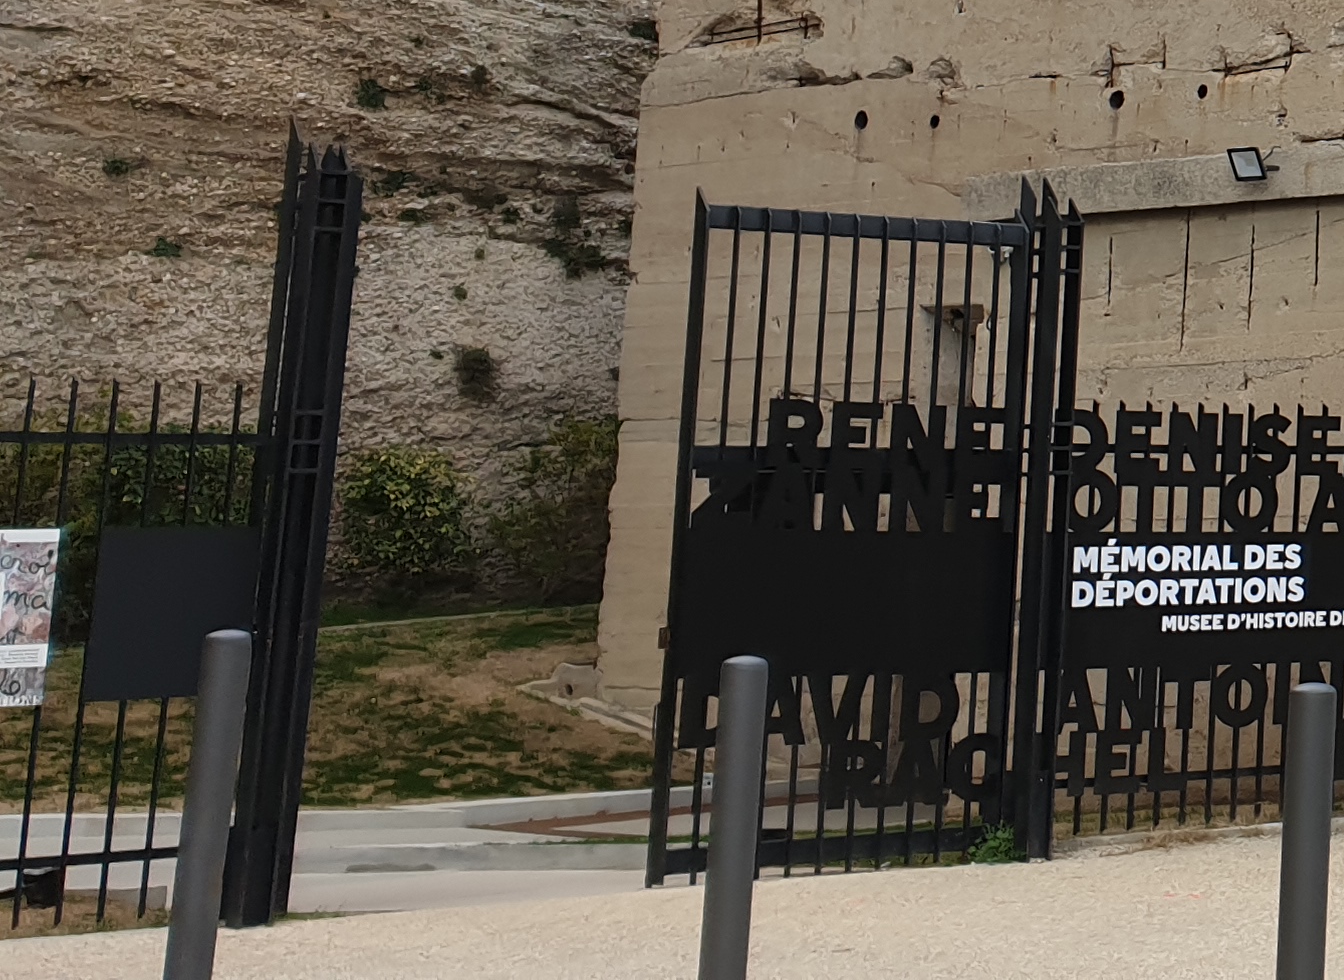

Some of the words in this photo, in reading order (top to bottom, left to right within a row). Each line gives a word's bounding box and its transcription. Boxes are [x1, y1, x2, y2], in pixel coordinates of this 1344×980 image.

[1071, 407, 1343, 475] DENISE
[1068, 469, 1281, 534] OTTO
[1073, 538, 1239, 573] MÉMORIAL
[1243, 543, 1302, 571] DES
[1071, 573, 1305, 608] DÉPORTATIONS
[1161, 613, 1225, 632] MUSEE
[1227, 610, 1327, 631] D'HISTOIRE
